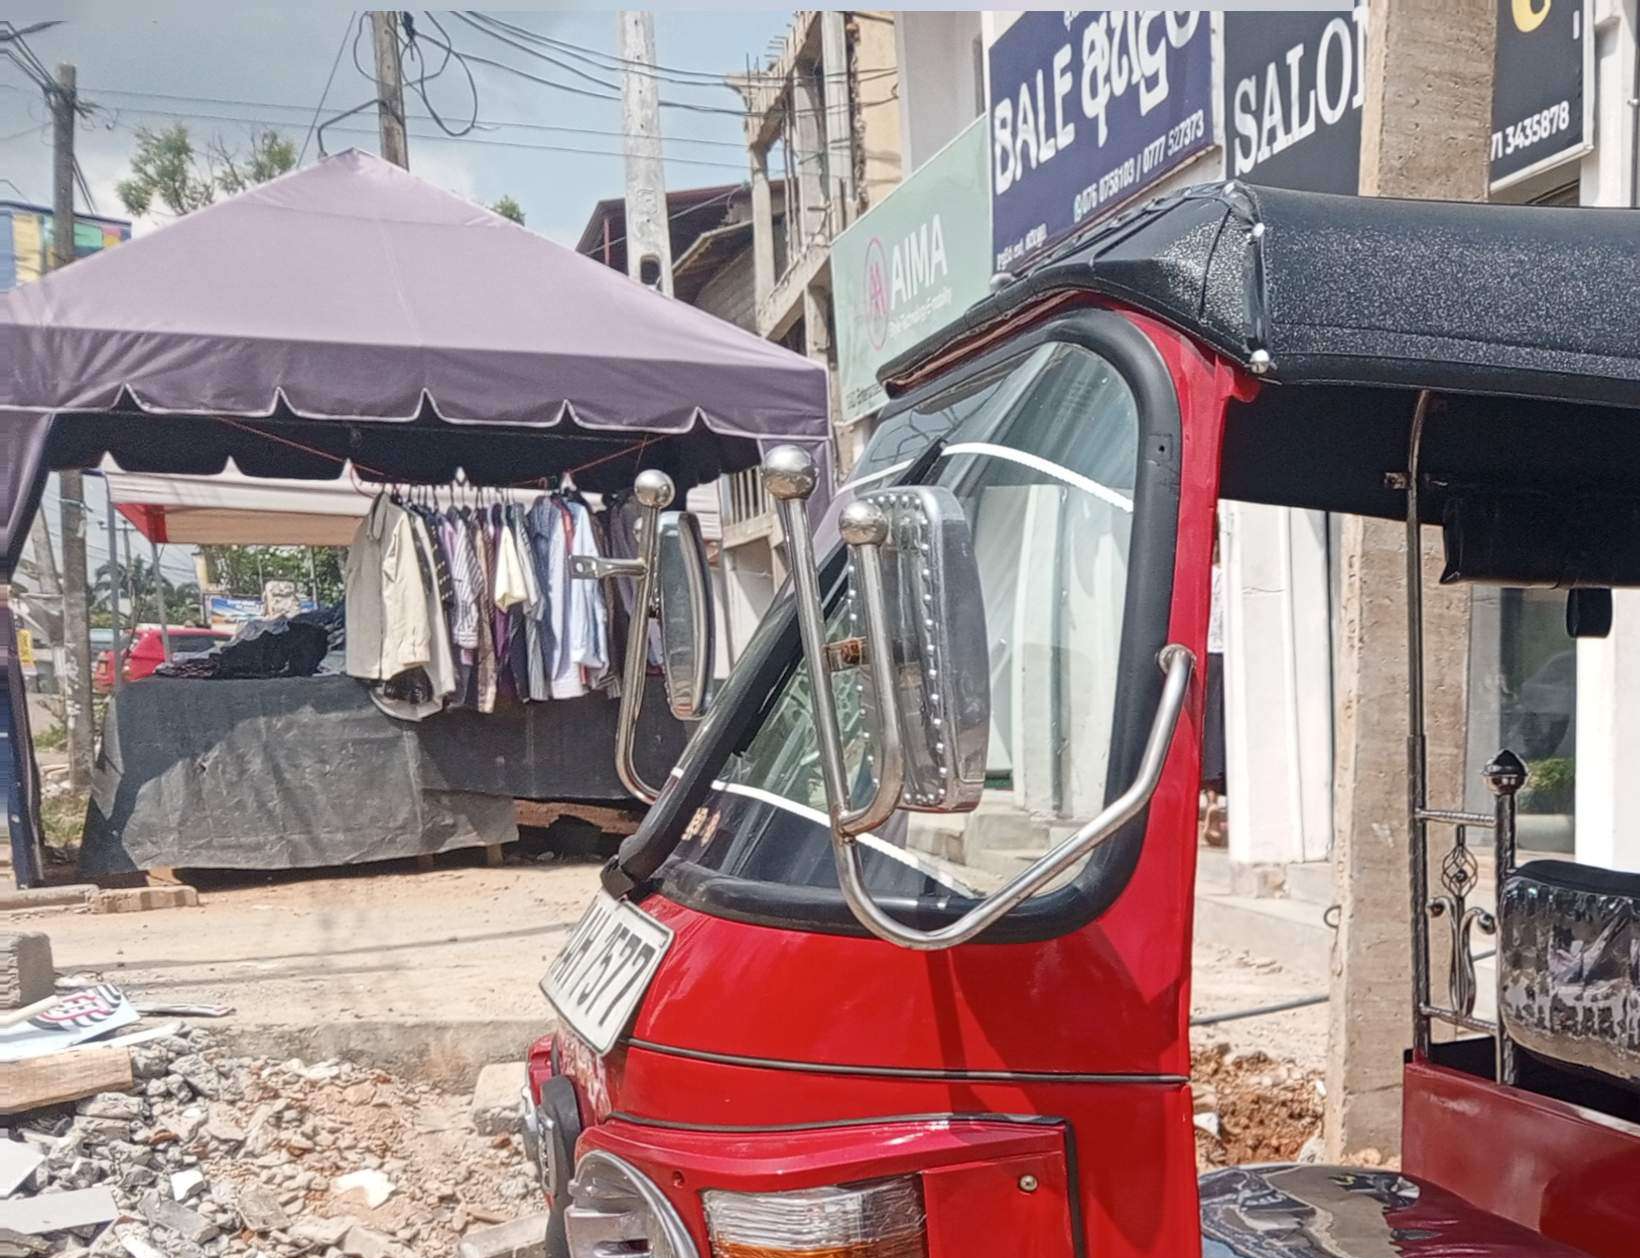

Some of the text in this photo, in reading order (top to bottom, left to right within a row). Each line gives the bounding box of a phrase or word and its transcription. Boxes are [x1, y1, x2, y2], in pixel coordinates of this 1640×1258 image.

[994, 43, 1076, 195] BALE
[1143, 134, 1166, 174] 0777
[1167, 109, 1204, 157] 527373
[1505, 100, 1570, 155] 3435878
[890, 213, 948, 311] AIMA
